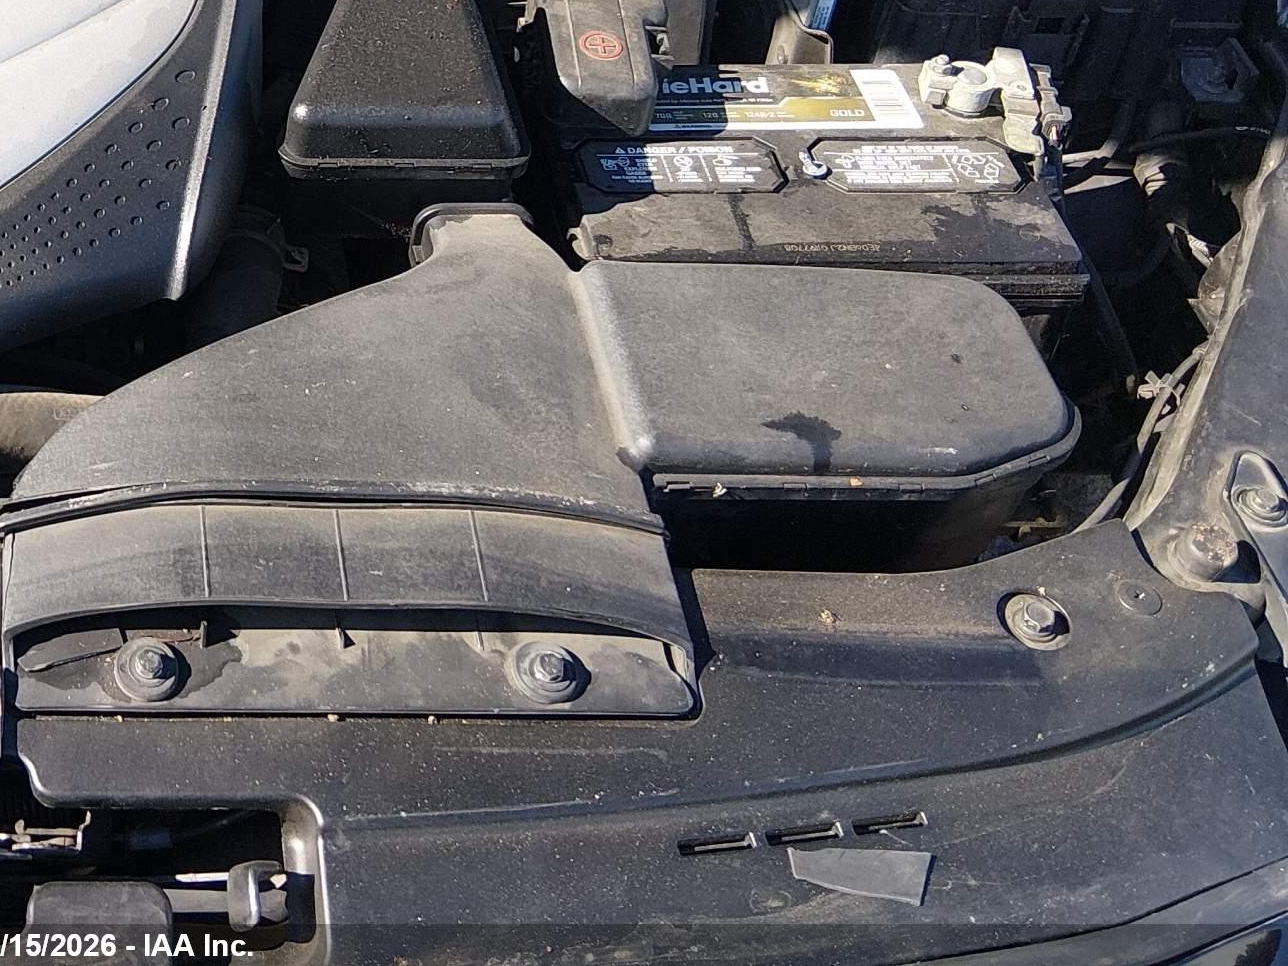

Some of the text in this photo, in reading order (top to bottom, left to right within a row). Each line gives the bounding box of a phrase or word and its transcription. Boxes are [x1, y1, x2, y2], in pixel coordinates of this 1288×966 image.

[662, 77, 770, 94] ieHard
[829, 109, 865, 117] GOLD
[626, 146, 678, 154] DANGER
[687, 145, 735, 153] POISON
